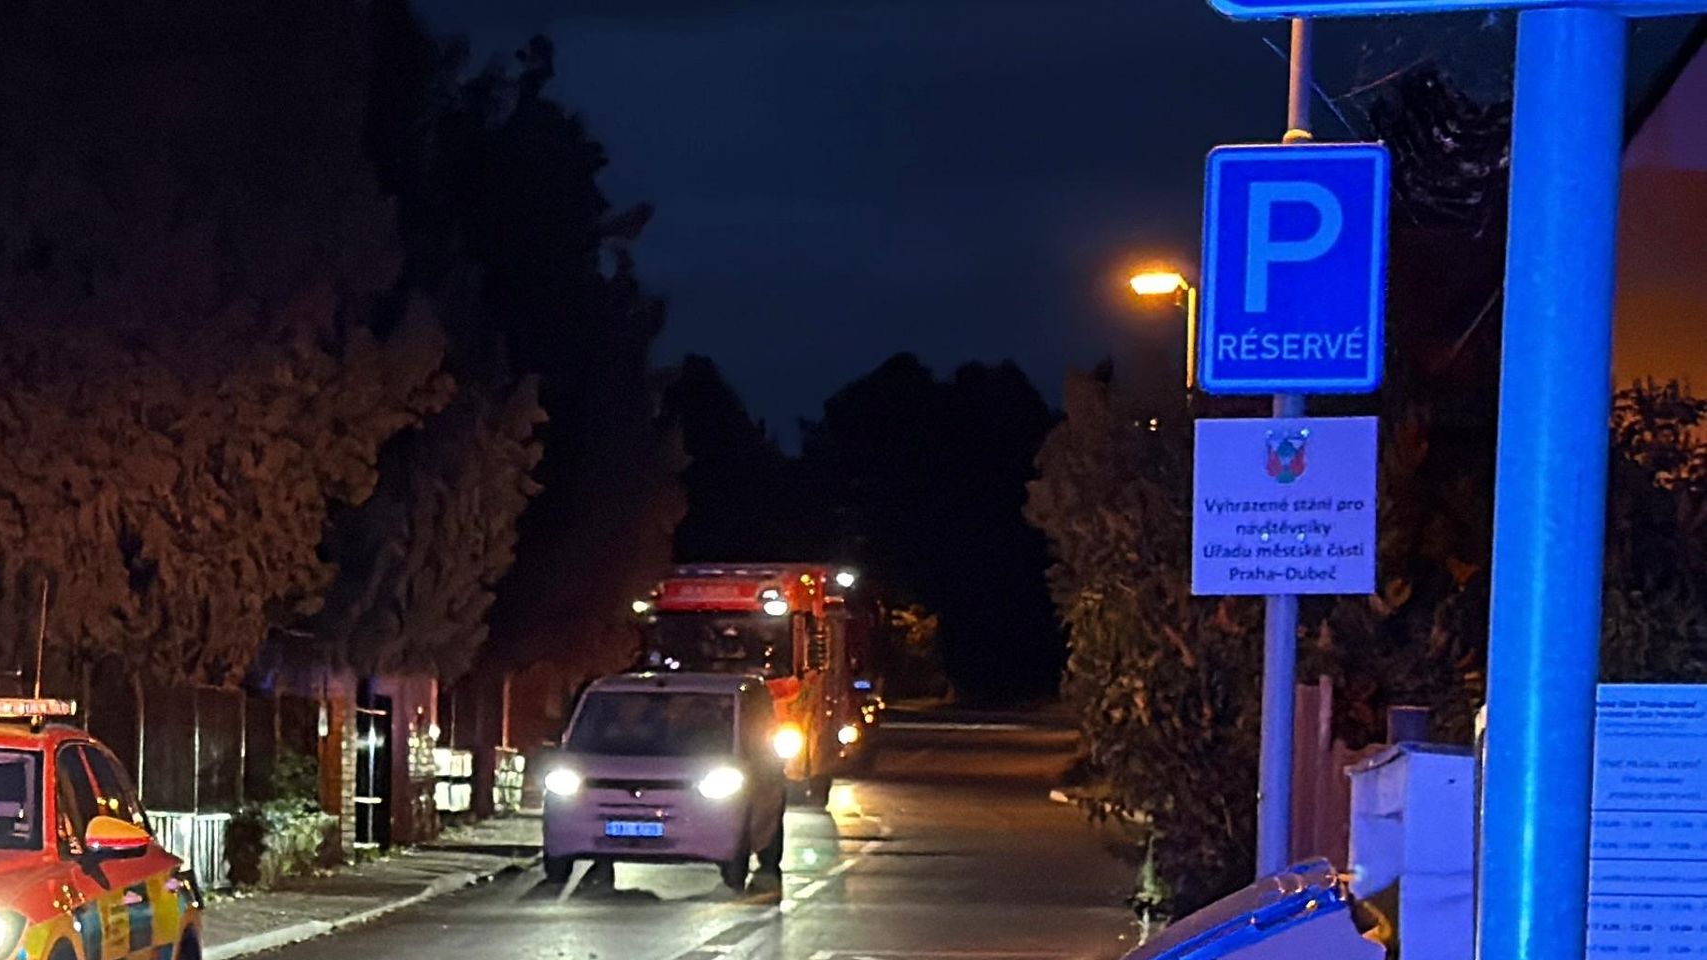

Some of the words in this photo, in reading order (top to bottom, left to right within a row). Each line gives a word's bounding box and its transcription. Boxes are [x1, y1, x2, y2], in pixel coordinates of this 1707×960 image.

[1245, 181, 1343, 313] P
[1218, 327, 1366, 360] RÉSERVÉ
[1336, 501, 1365, 513] pro
